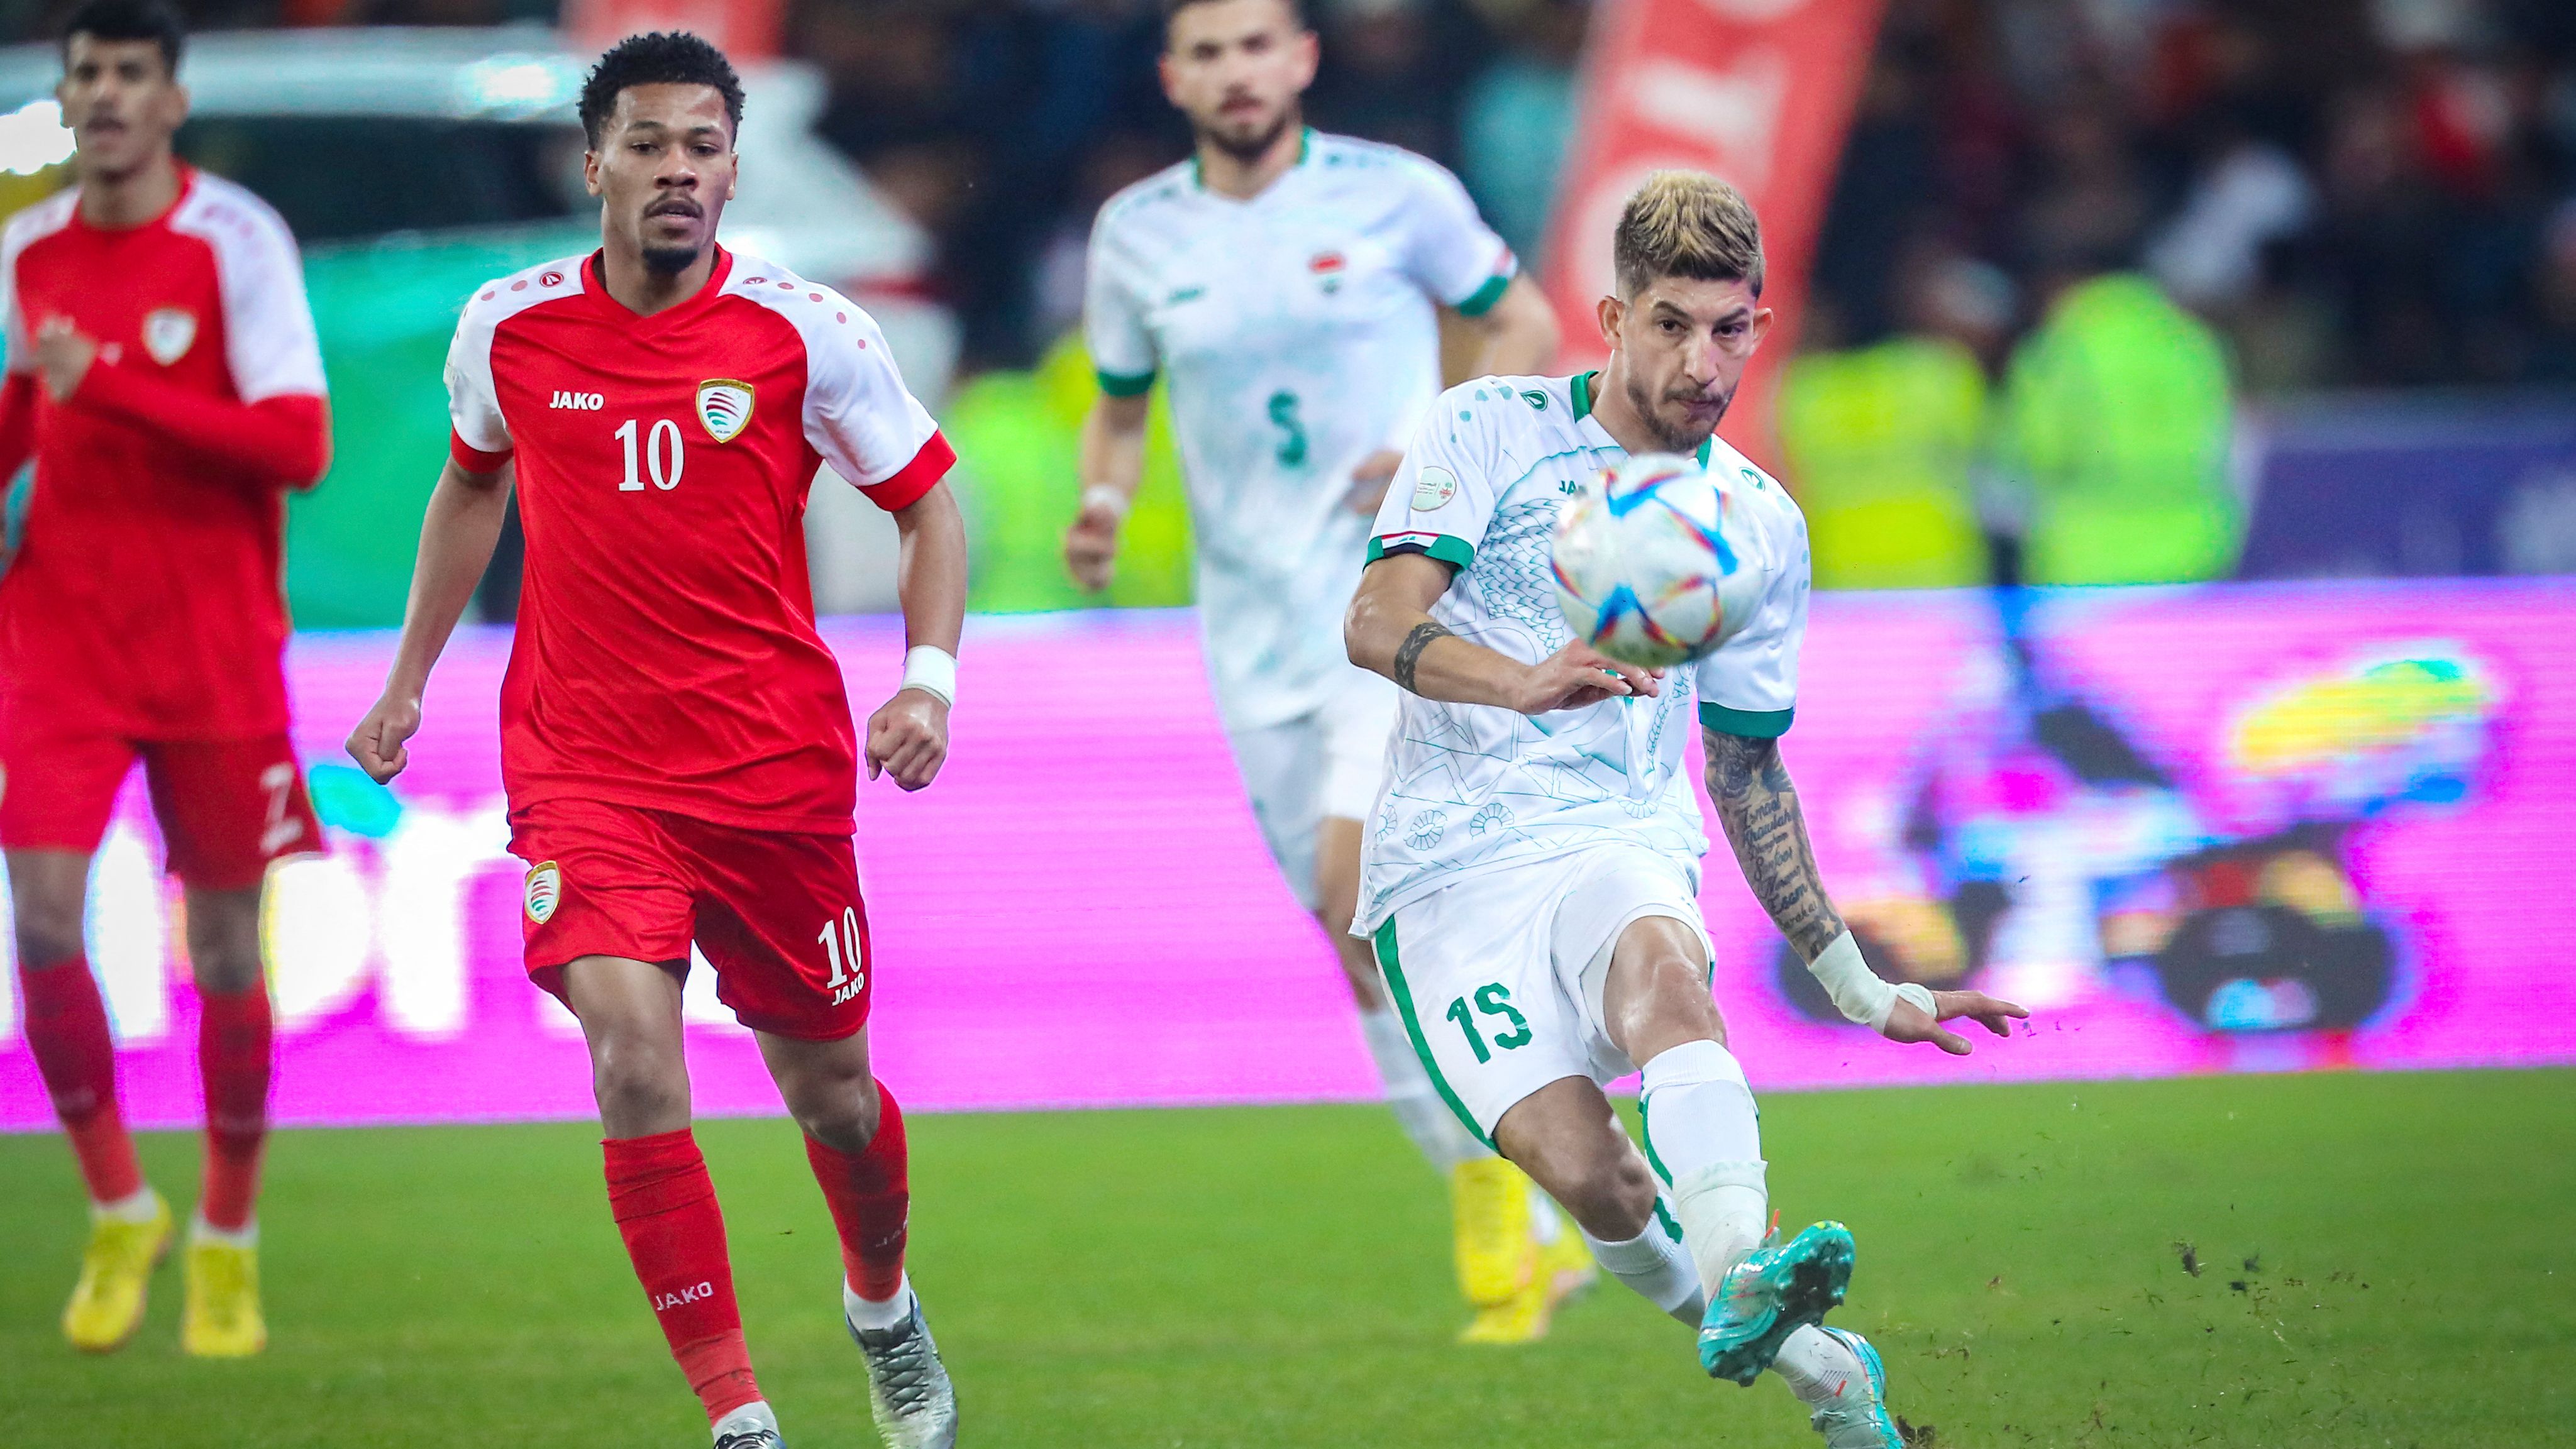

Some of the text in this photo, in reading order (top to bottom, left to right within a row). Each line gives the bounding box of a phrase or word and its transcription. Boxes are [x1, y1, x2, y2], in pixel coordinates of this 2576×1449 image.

[549, 391, 604, 410] JAKO
[614, 419, 684, 491] 10
[259, 761, 303, 856] 2
[818, 906, 862, 989] 10
[832, 972, 864, 1006] JAKO
[656, 1281, 714, 1311] JAKO
